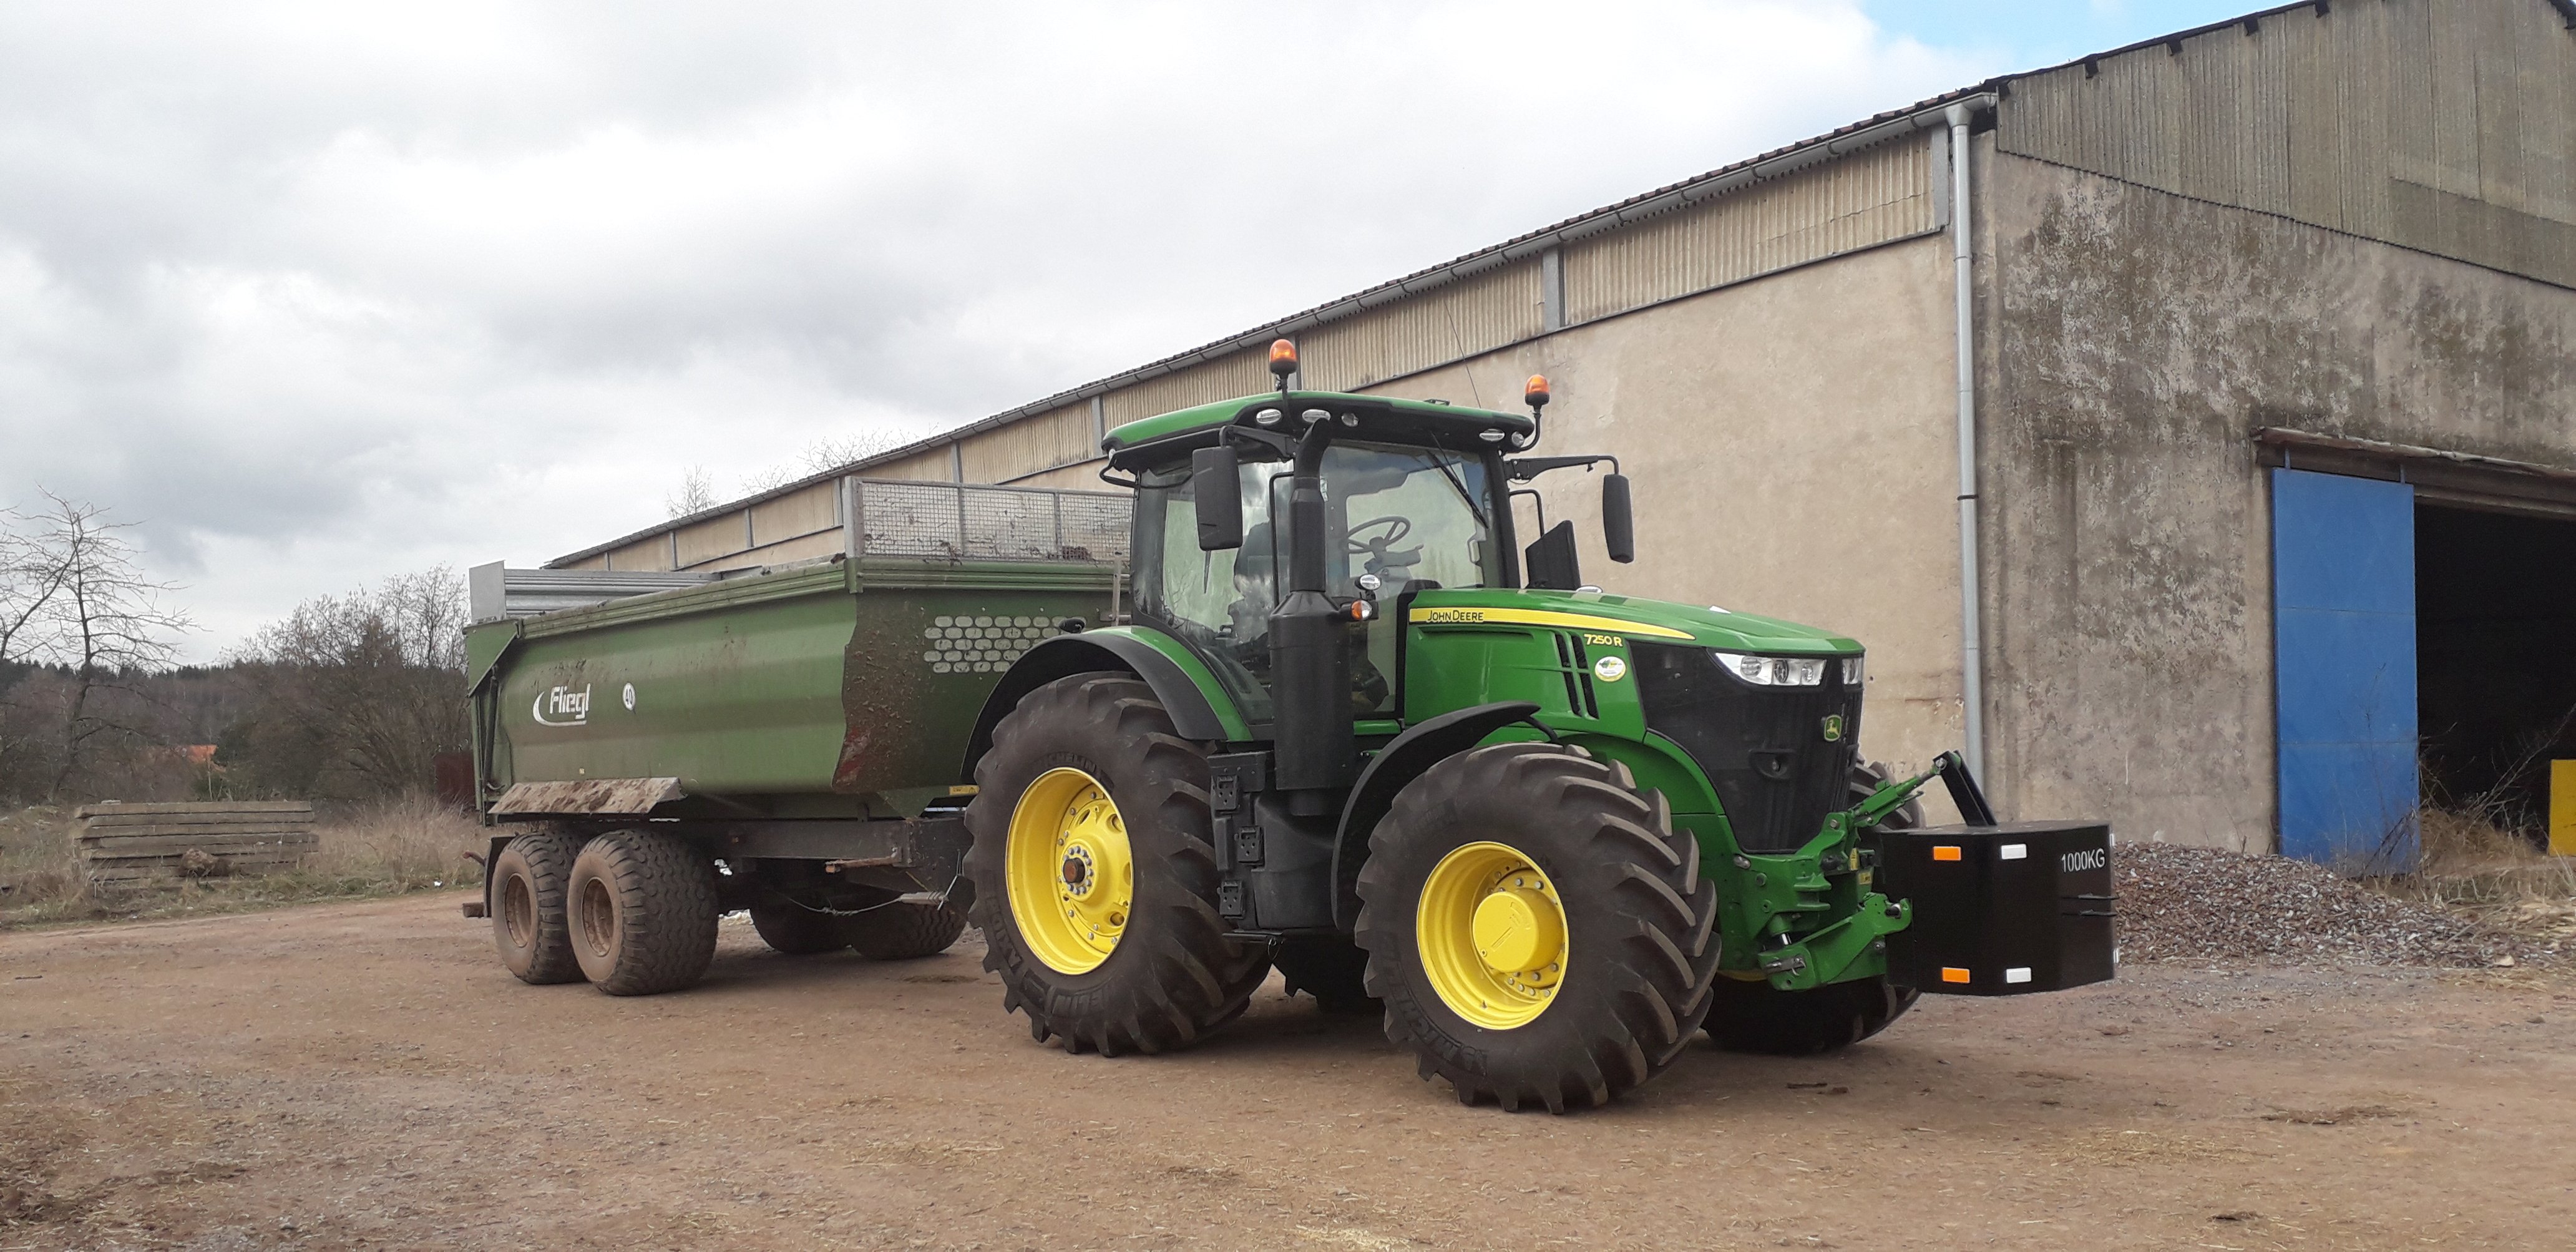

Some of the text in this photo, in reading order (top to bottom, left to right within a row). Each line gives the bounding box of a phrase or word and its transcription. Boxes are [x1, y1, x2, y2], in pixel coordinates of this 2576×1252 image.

[1428, 610, 1484, 621] JOHN DEERE
[1584, 633, 1623, 647] 7250 R
[549, 683, 591, 720] Fliegl
[2061, 848, 2105, 873] 1000KG
